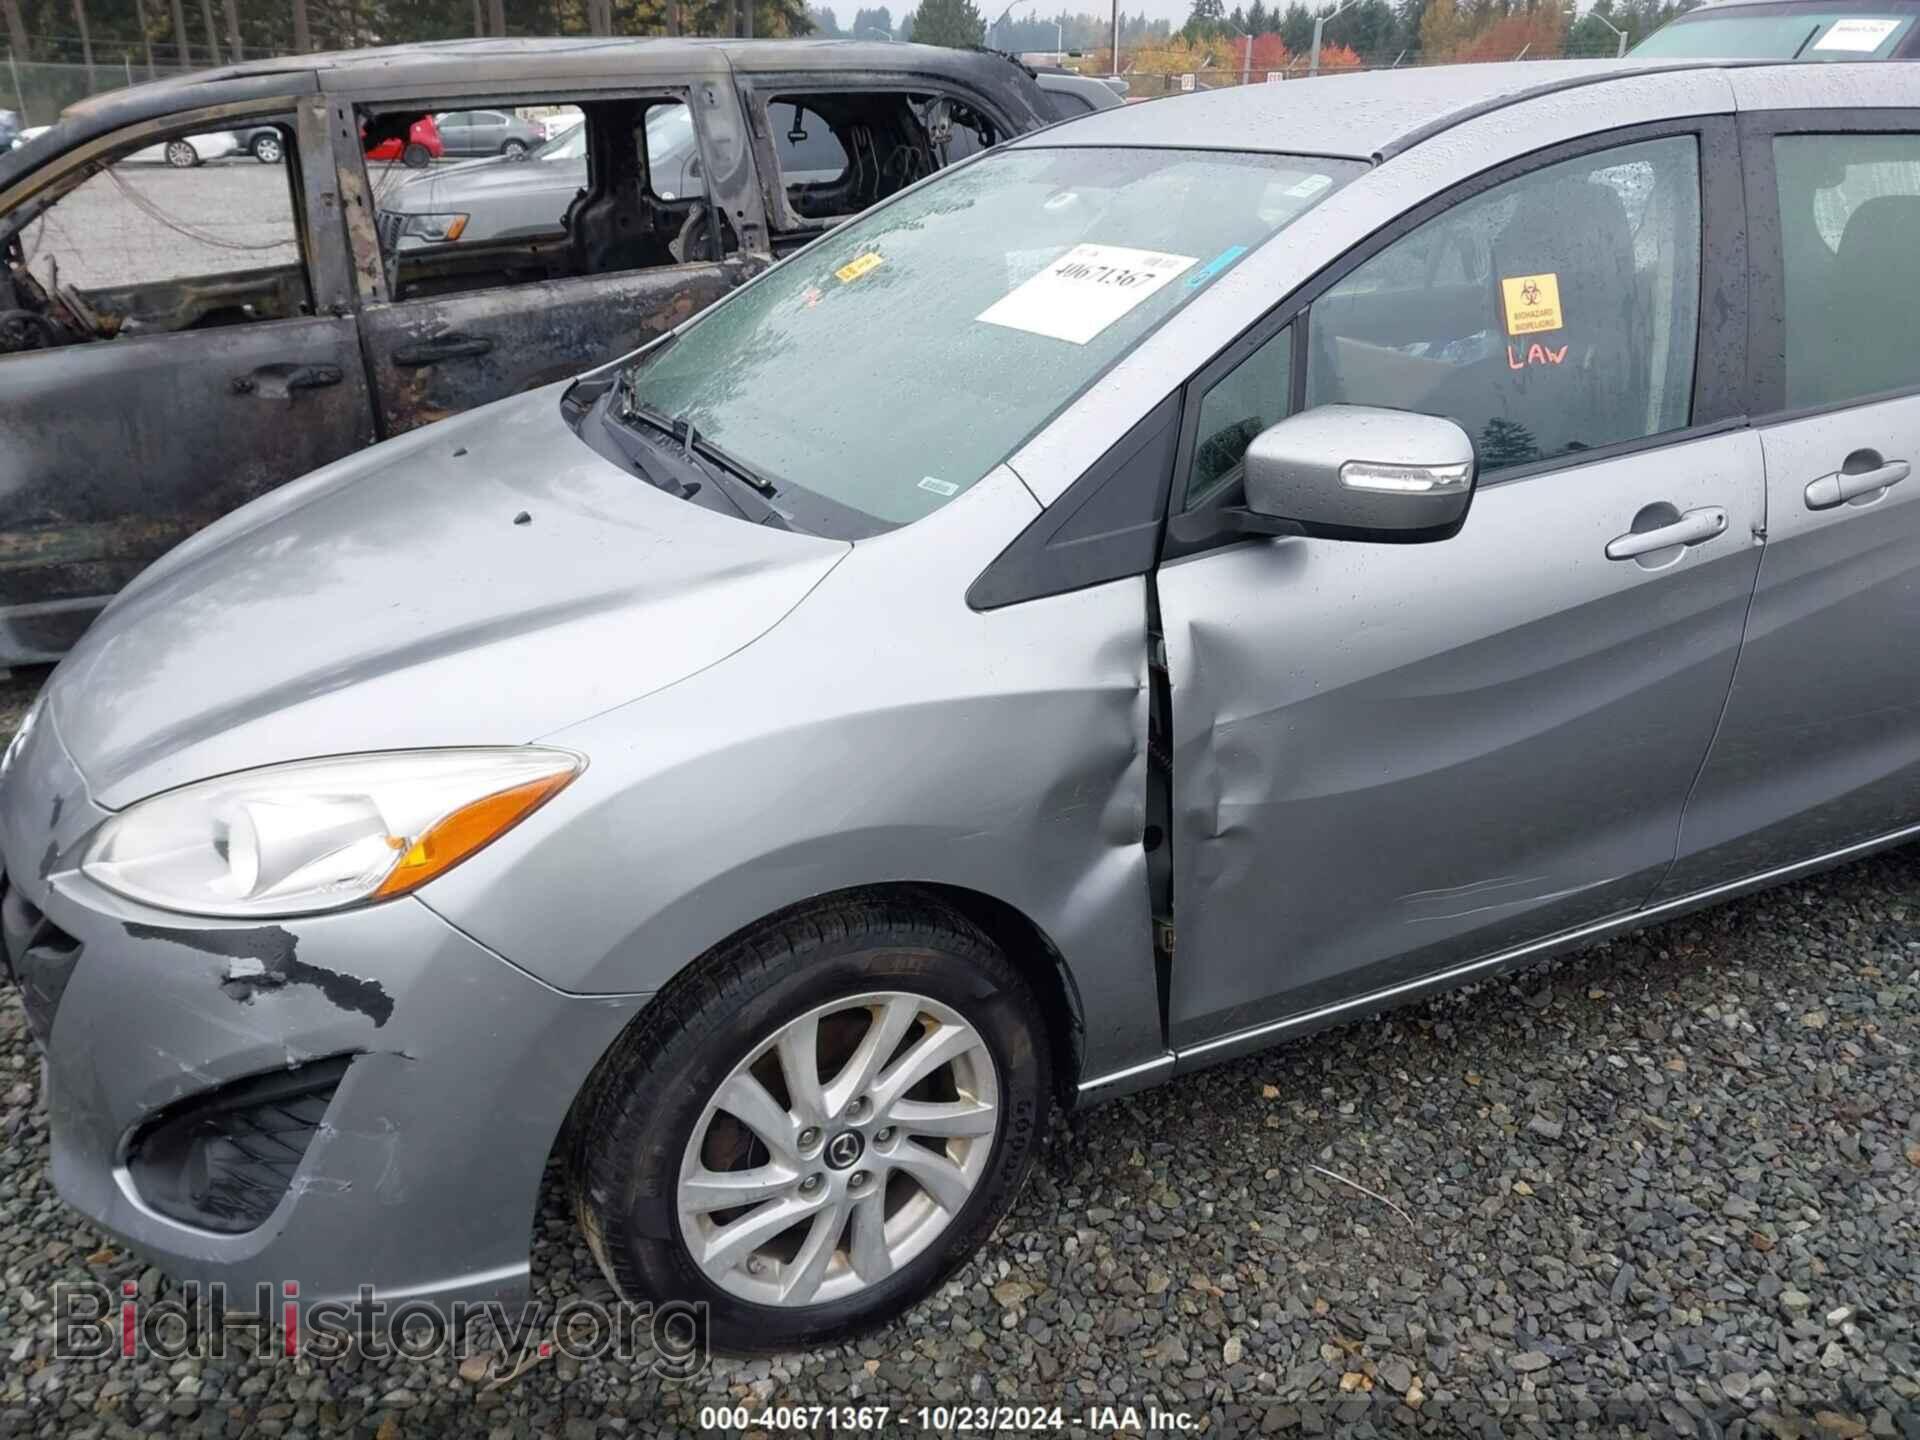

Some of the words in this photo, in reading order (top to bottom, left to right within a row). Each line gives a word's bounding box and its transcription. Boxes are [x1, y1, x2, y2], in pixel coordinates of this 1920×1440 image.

[1055, 262, 1156, 288] 40671367
[1513, 308, 1553, 320] BIOHAZARD
[1507, 343, 1569, 369] LAW
